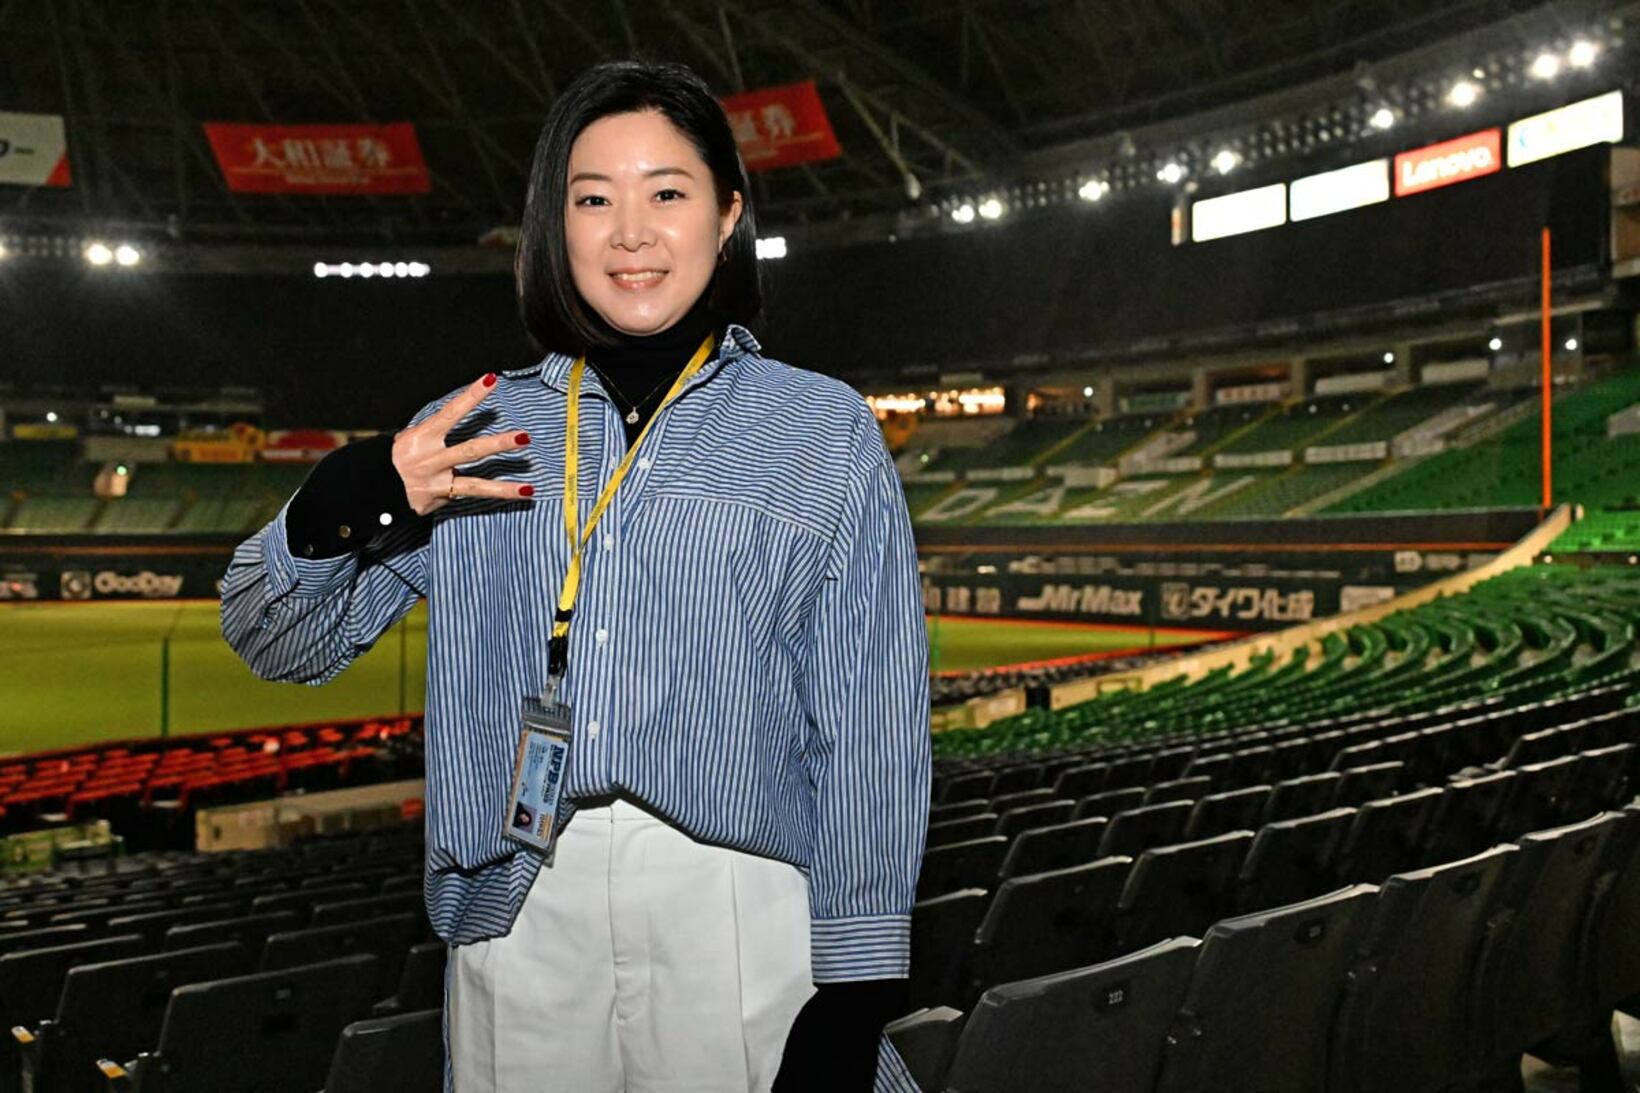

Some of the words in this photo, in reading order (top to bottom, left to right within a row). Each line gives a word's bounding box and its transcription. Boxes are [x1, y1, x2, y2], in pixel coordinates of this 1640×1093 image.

[1402, 146, 1492, 187] Lenovo
[1018, 585, 1143, 616] MrMax
[548, 745, 565, 785] NPB
